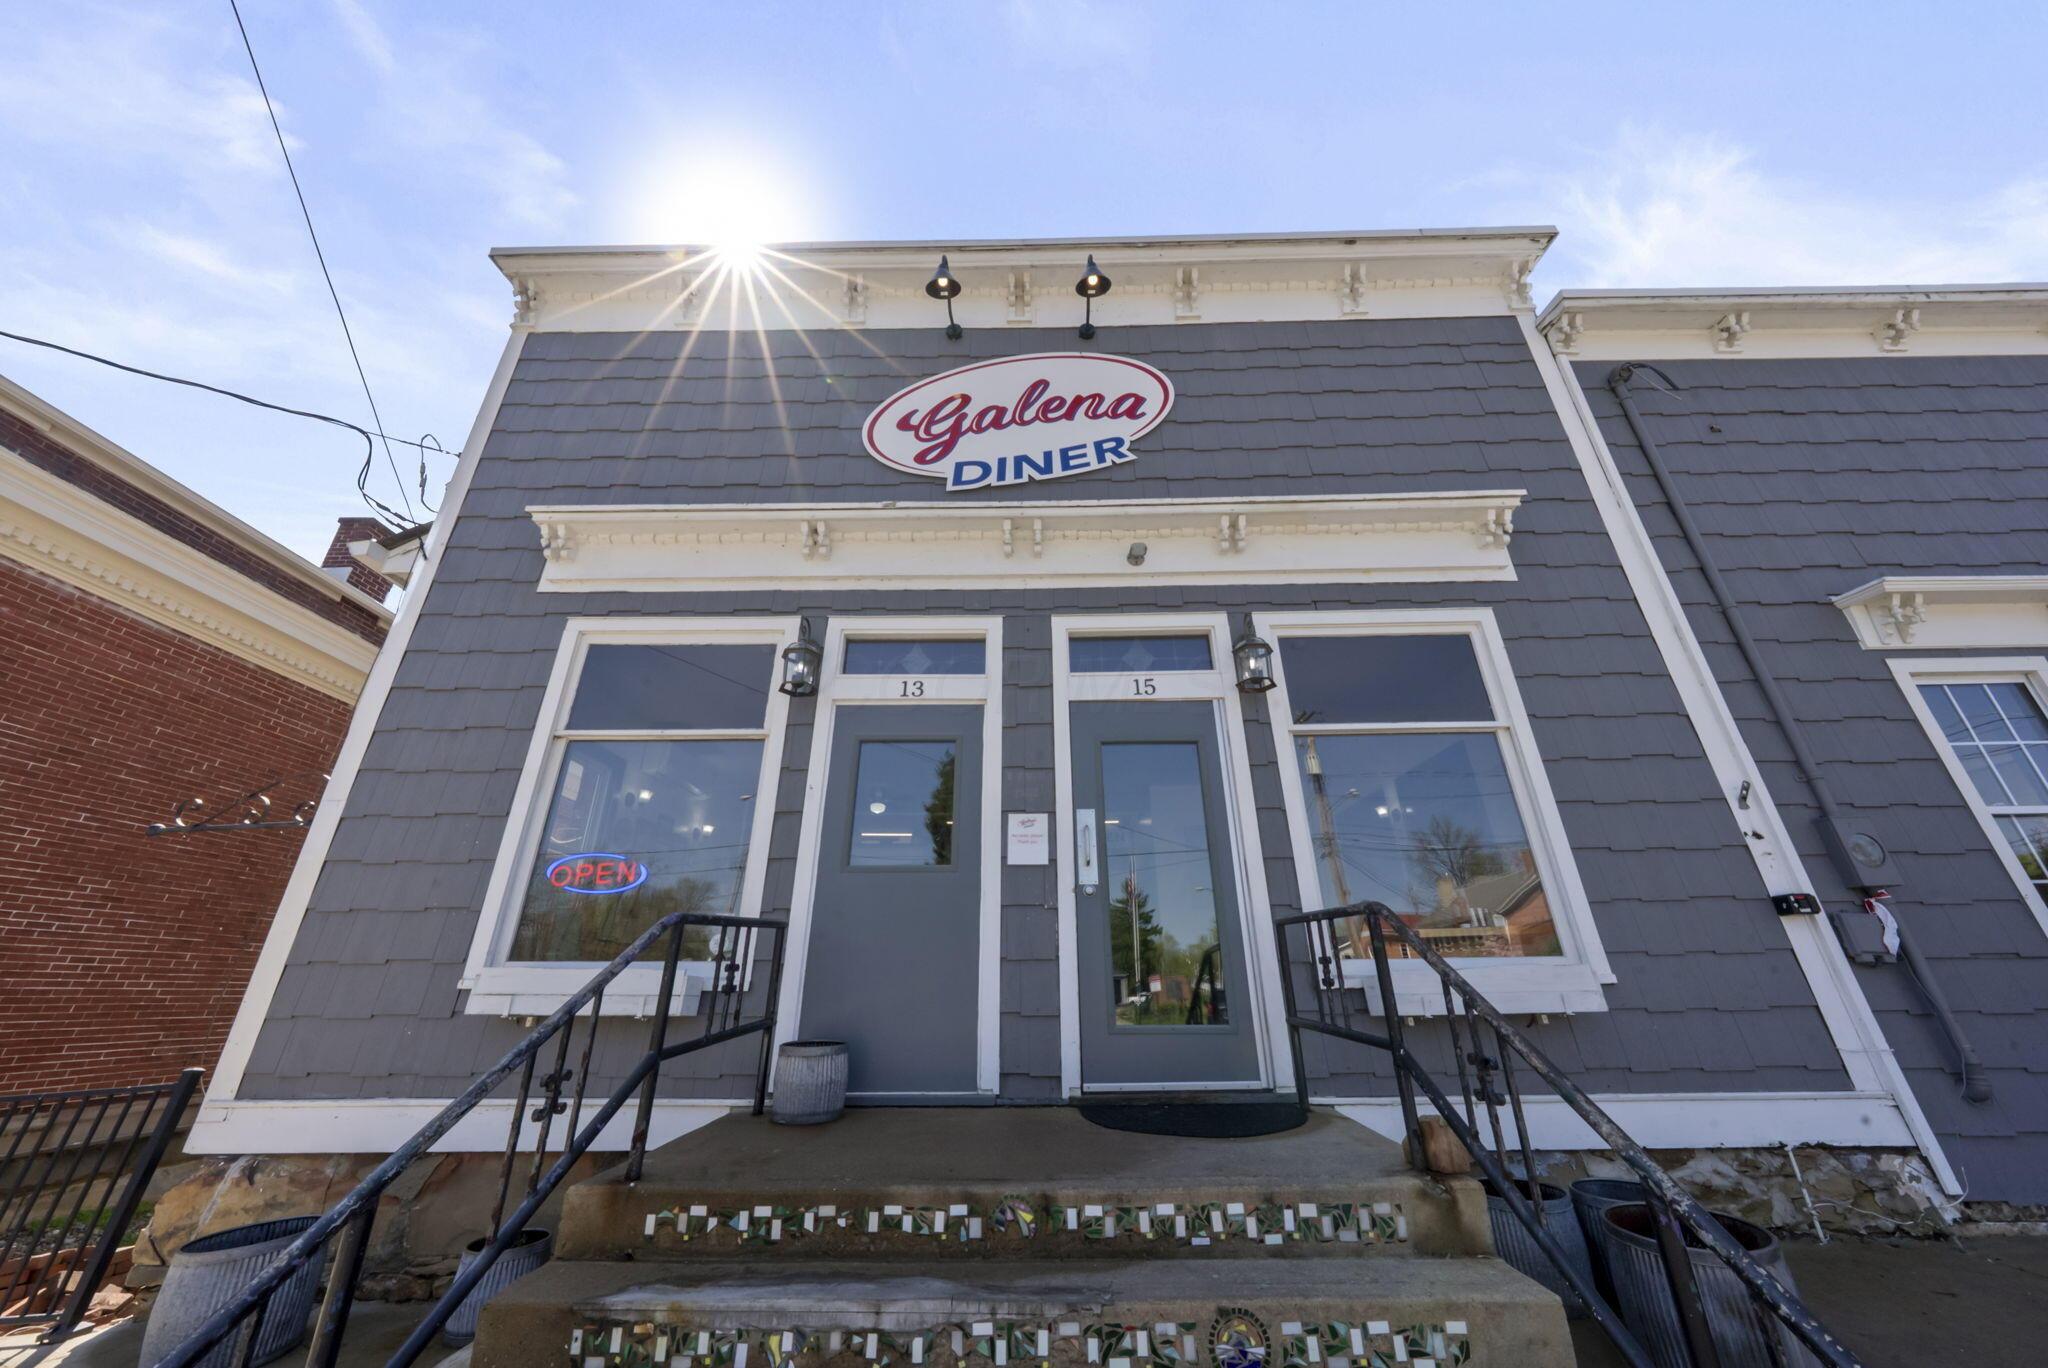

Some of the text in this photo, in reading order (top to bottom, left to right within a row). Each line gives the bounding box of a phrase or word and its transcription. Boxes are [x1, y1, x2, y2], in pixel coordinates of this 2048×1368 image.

[896, 379, 1147, 466] Galena
[951, 436, 1129, 487] DINER
[900, 681, 924, 698] 13
[1133, 678, 1156, 696] 15
[551, 861, 637, 887] OPEN
